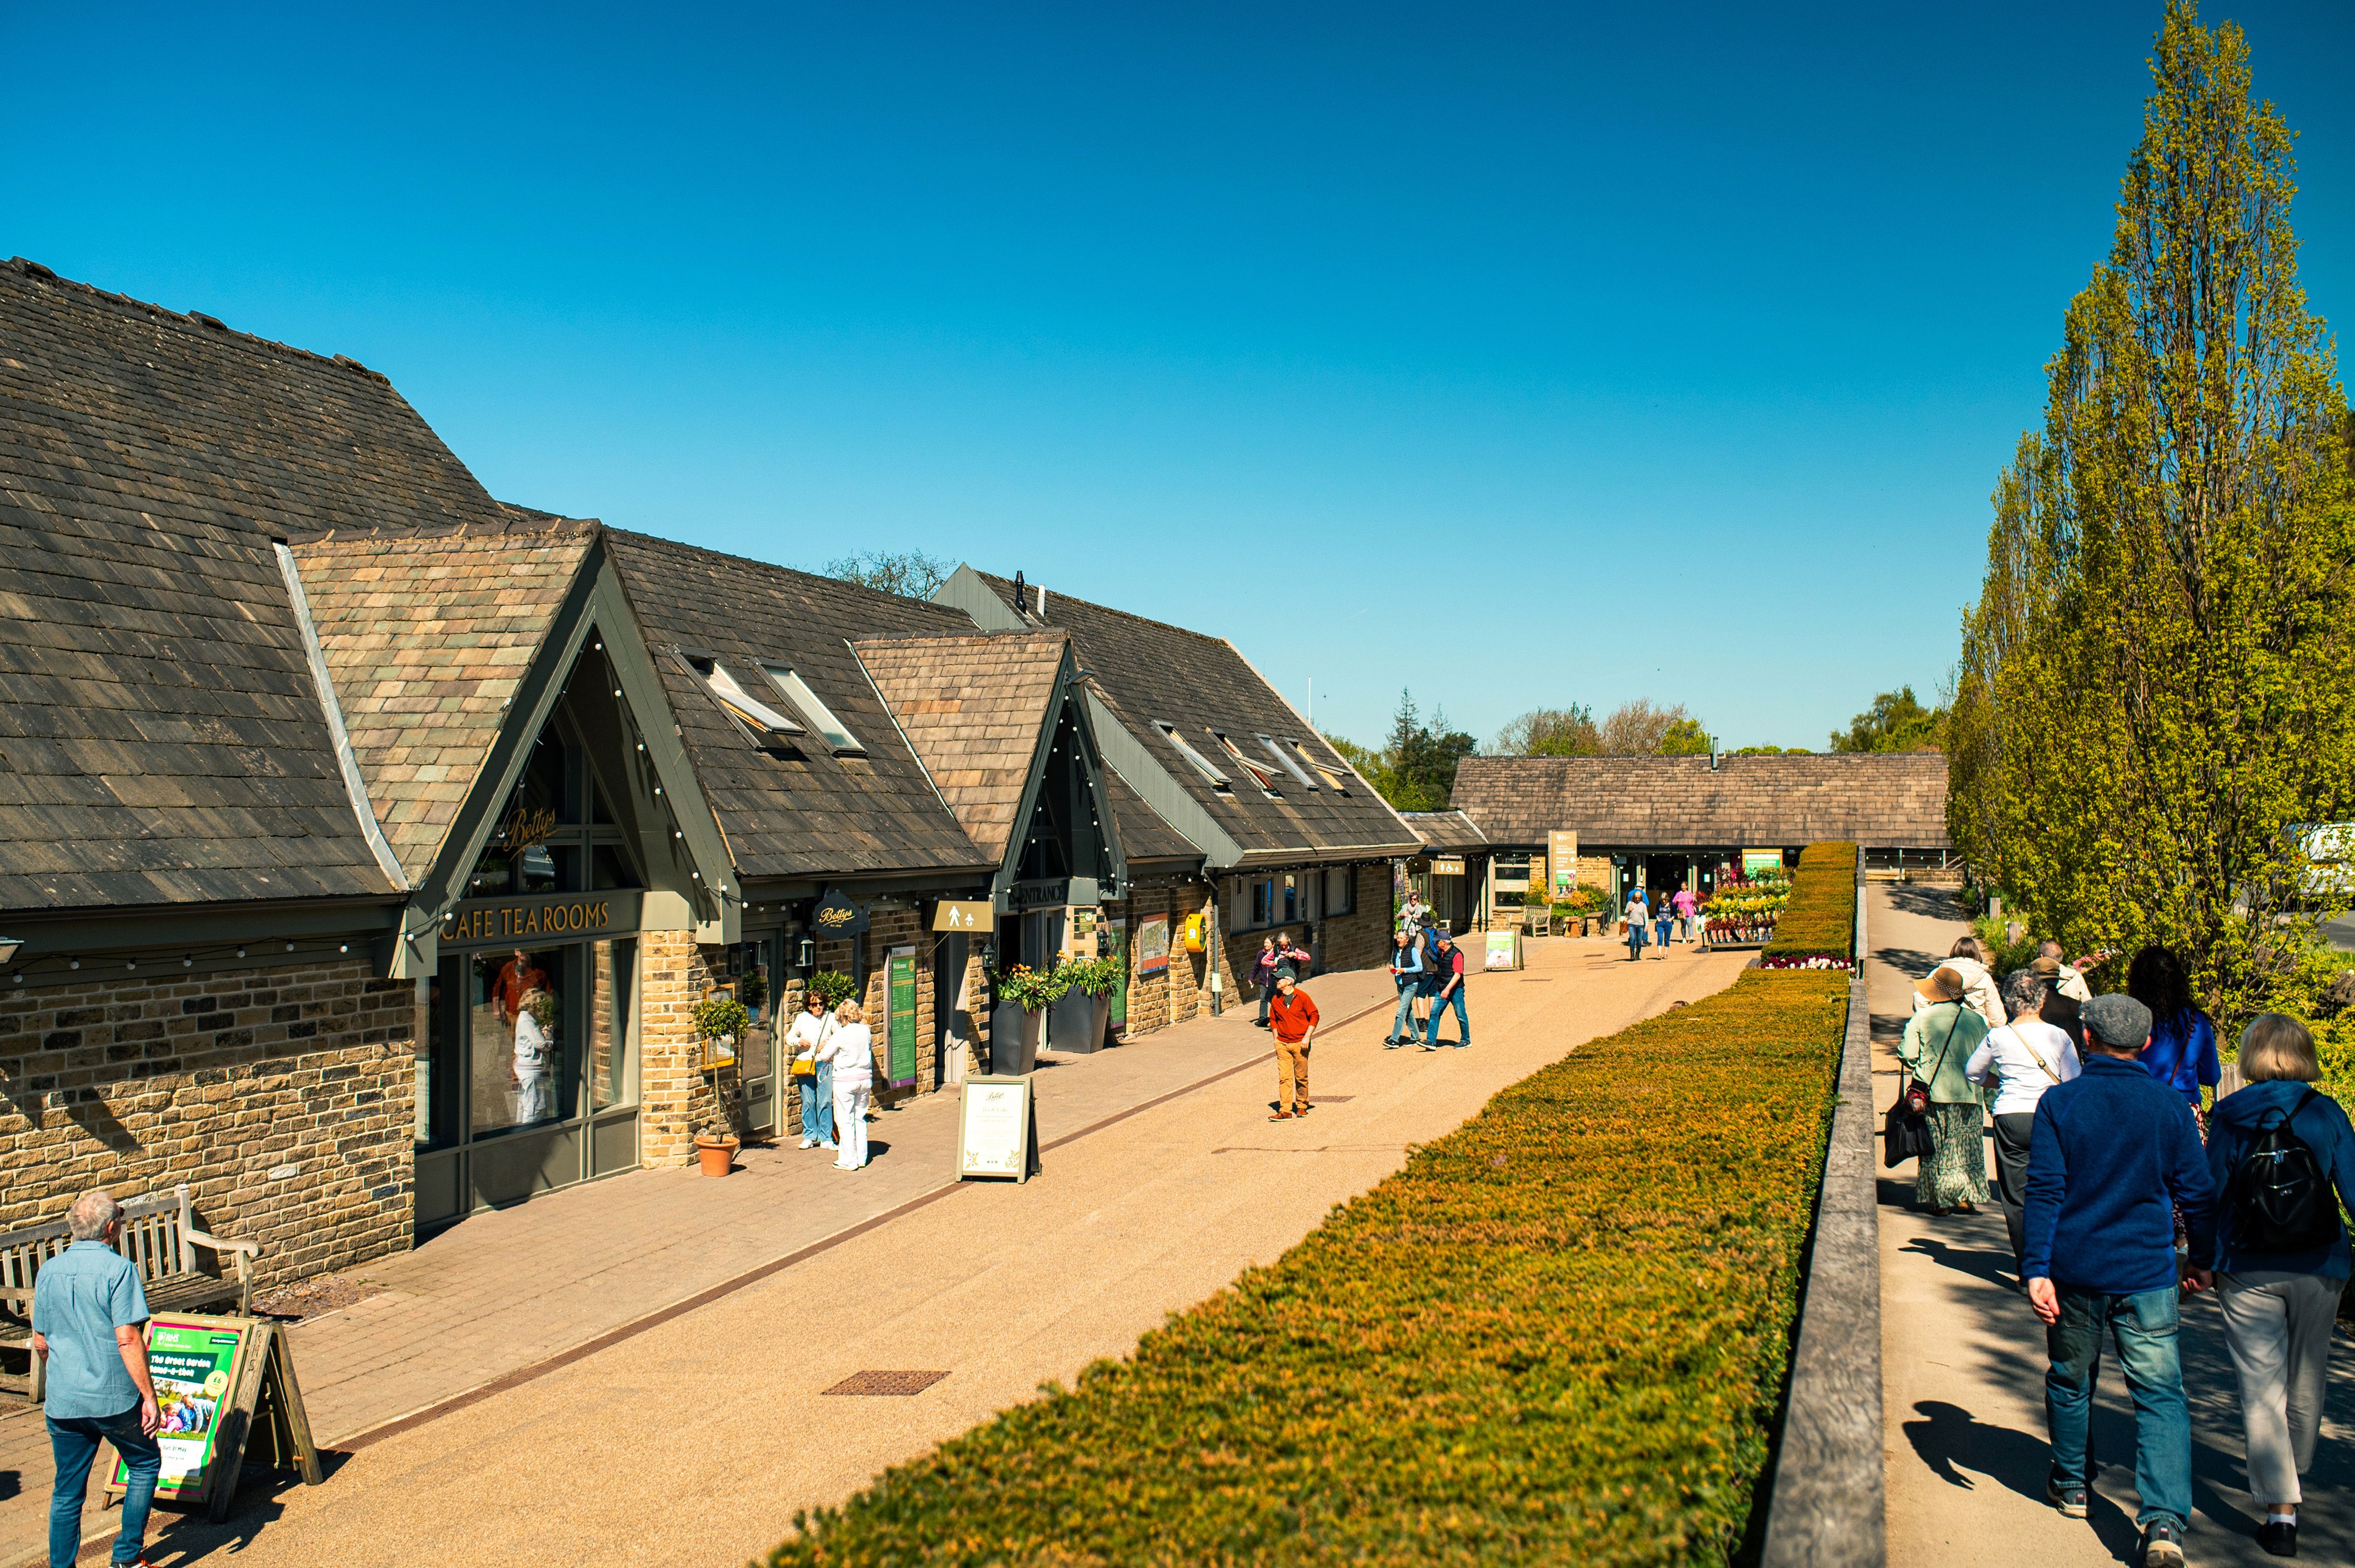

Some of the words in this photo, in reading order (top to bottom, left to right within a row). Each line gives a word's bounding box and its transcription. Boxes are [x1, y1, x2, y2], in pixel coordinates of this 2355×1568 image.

[503, 807, 559, 855] Bettys
[1021, 884, 1064, 904] ENTRANCE
[500, 908, 539, 935] TEA
[543, 901, 609, 932] ROOMS
[818, 907, 854, 924] Bettys
[165, 1333, 180, 1343] RHS
[248, 1330, 262, 1372] RHS
[151, 1355, 164, 1364] The
[164, 1356, 185, 1366] Great
[186, 1358, 211, 1368] Garden
